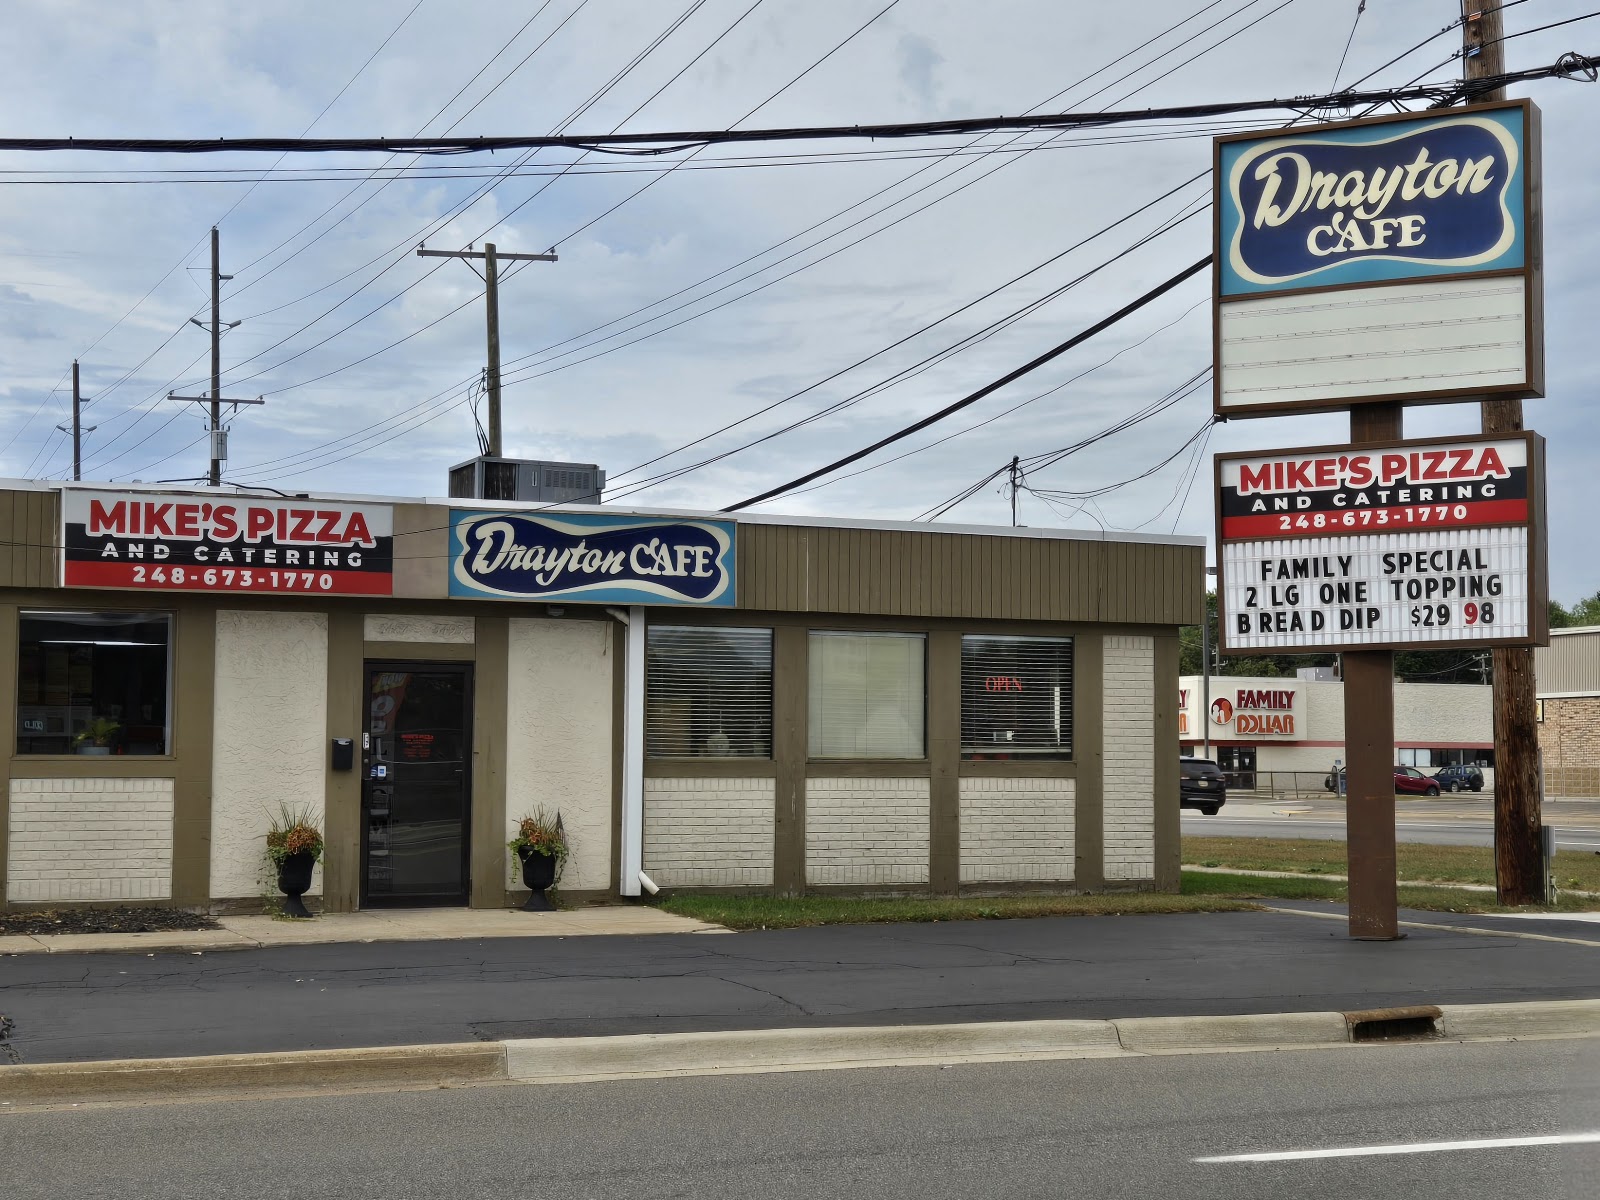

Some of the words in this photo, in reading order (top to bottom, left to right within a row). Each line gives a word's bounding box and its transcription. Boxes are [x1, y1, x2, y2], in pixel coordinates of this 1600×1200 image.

[1254, 146, 1495, 230] Drayton
[1306, 211, 1427, 257] CAFE
[1239, 455, 1374, 492] MIKE'S
[1381, 447, 1507, 483] PIZZA
[1251, 495, 1311, 512] AND
[1333, 483, 1497, 508] CATERING
[90, 499, 238, 539] MIKE'S
[247, 507, 373, 544] PIZZA
[1279, 504, 1468, 531] 248-673-1770
[101, 542, 170, 559] AND
[193, 545, 362, 567] CATERING
[471, 521, 627, 586] Drayton
[629, 537, 714, 577] CAFE
[1261, 555, 1353, 581] FAMILY
[1382, 548, 1488, 575] SPECIAL
[132, 565, 333, 590] 248-673-1770
[1245, 586, 1257, 608] 2
[1271, 583, 1300, 606] LG
[1319, 581, 1368, 604] ONE
[1390, 574, 1502, 601] TOPPING
[1340, 607, 1381, 630] DIP
[1463, 601, 1495, 625] 98
[985, 675, 1023, 692] OPEN
[1237, 690, 1296, 709] FAMILY
[1237, 714, 1294, 733] DOLLAR
